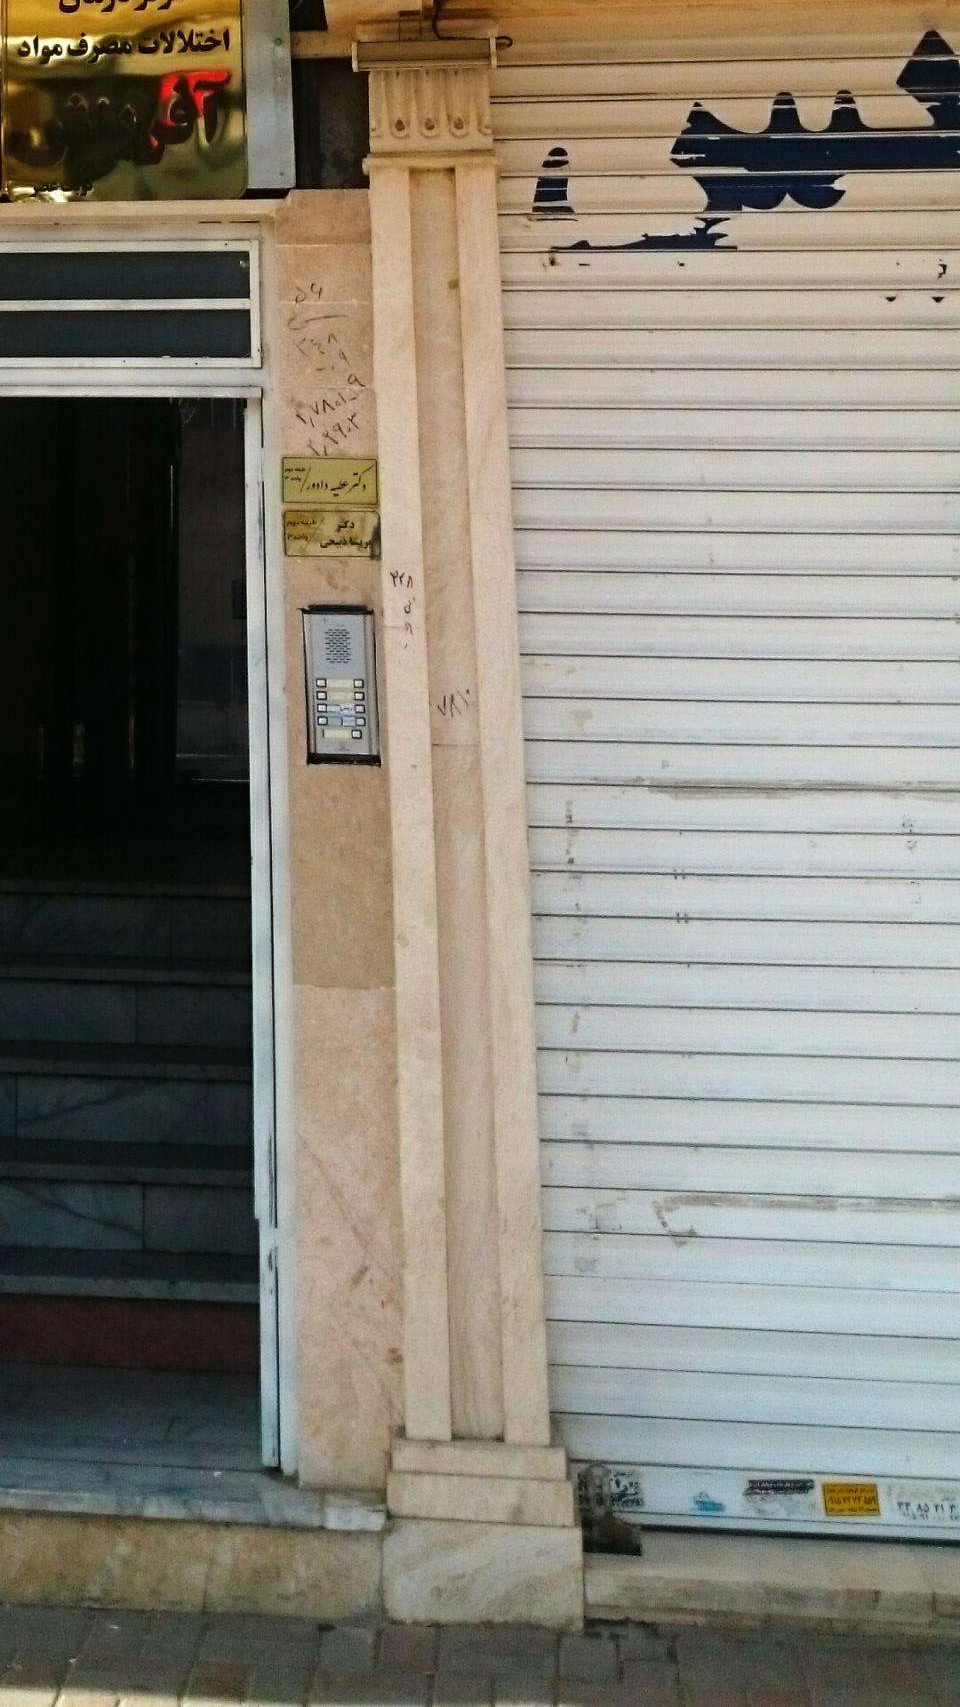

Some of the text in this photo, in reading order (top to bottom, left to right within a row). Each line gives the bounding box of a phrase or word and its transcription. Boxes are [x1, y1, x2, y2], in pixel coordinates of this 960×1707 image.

[17, 28, 230, 66] اختلالات مصرف مواد
